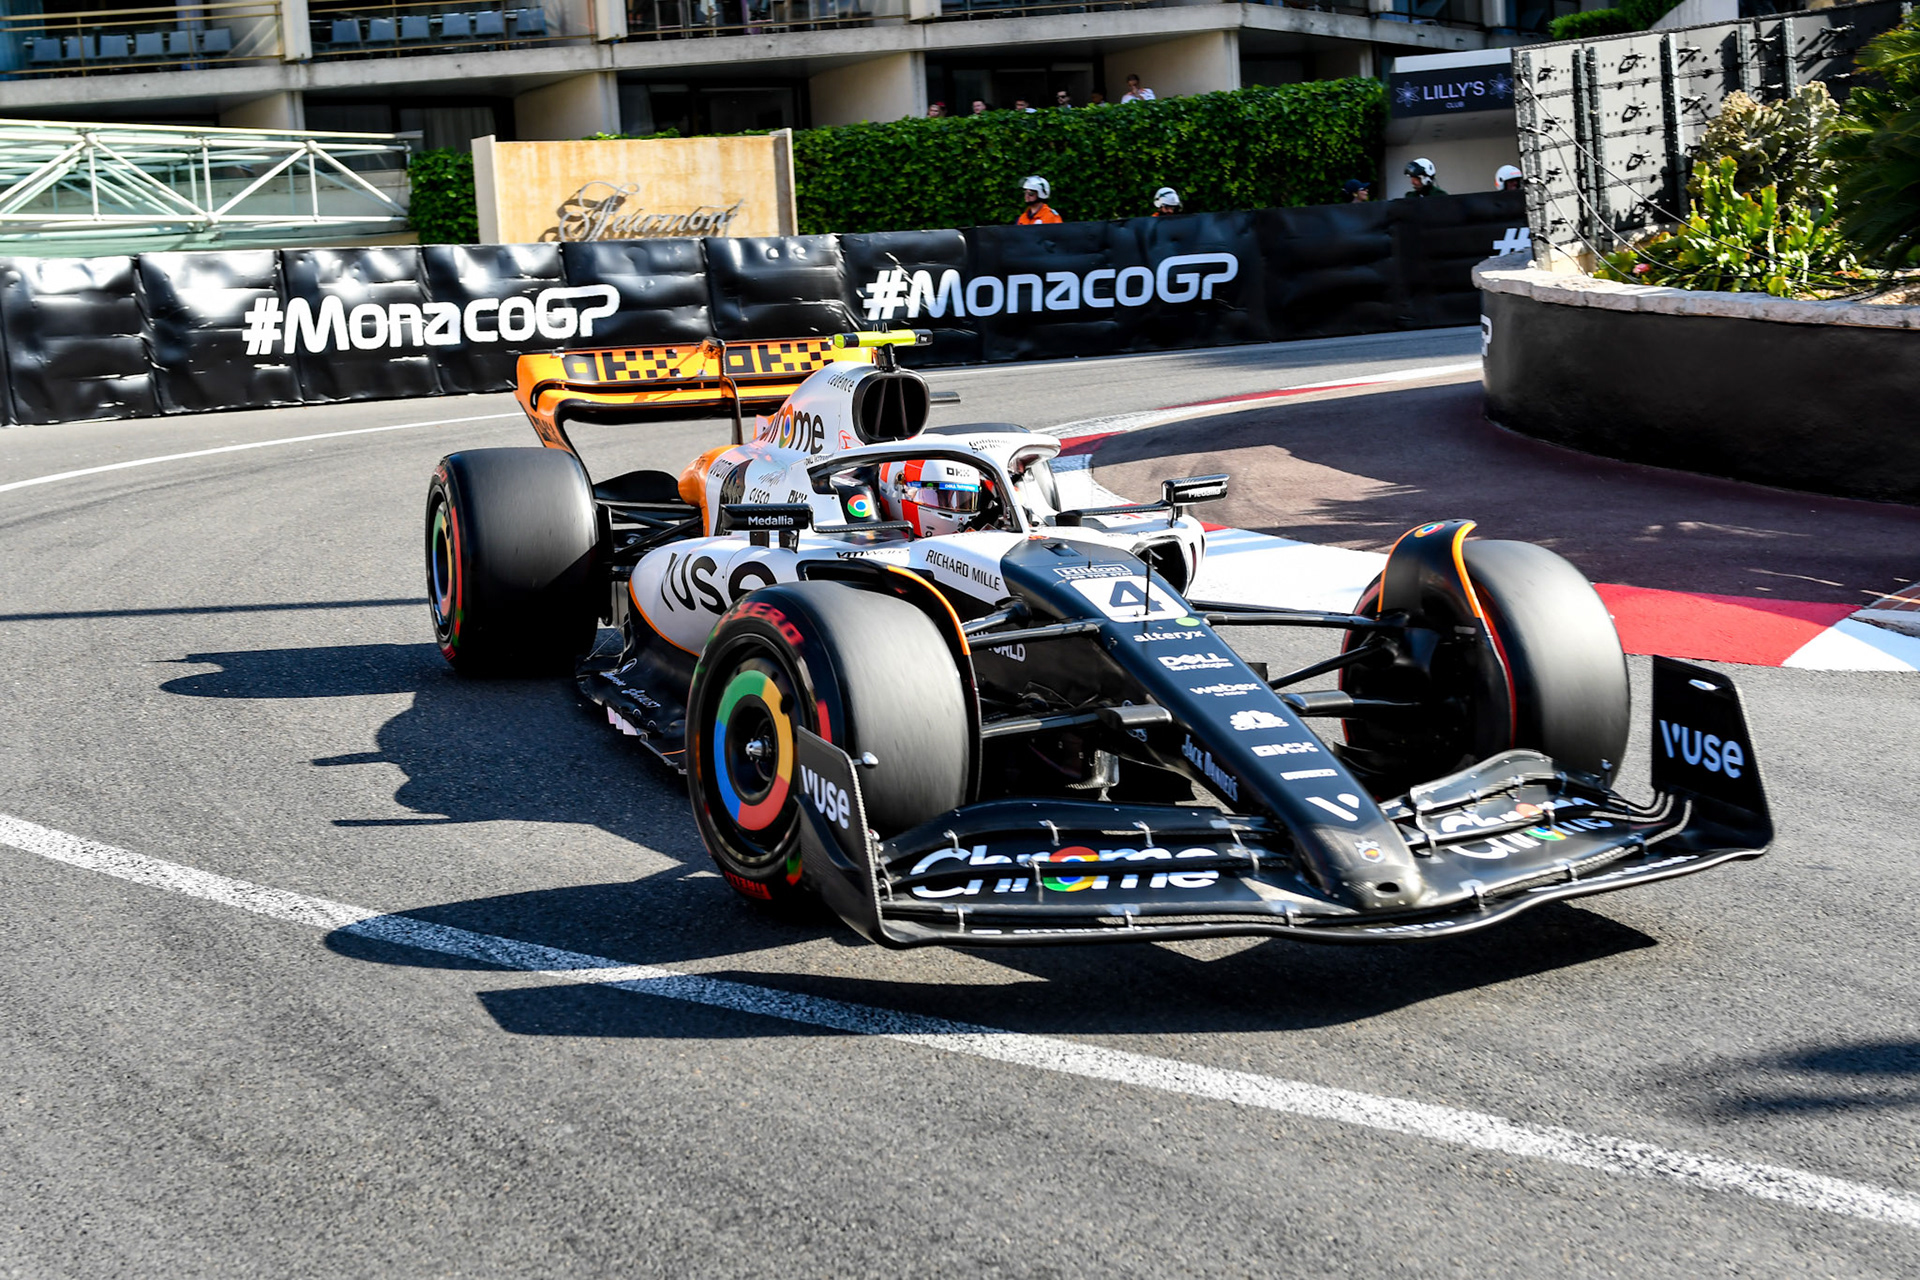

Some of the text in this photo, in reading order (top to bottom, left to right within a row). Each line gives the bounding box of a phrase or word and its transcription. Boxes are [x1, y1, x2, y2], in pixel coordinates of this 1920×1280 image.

[1423, 80, 1485, 100] LILLY'S
[558, 181, 745, 242] Fairmont
[862, 252, 1239, 321] #MonacoGP
[242, 283, 620, 355] #MonacoGP
[747, 516, 794, 526] Medallia
[925, 549, 1001, 592] RICHARD MILLE
[1061, 565, 1124, 576] Hilton
[1109, 580, 1166, 612] 4
[1133, 630, 1206, 643] alteryx
[1190, 683, 1262, 695] webex
